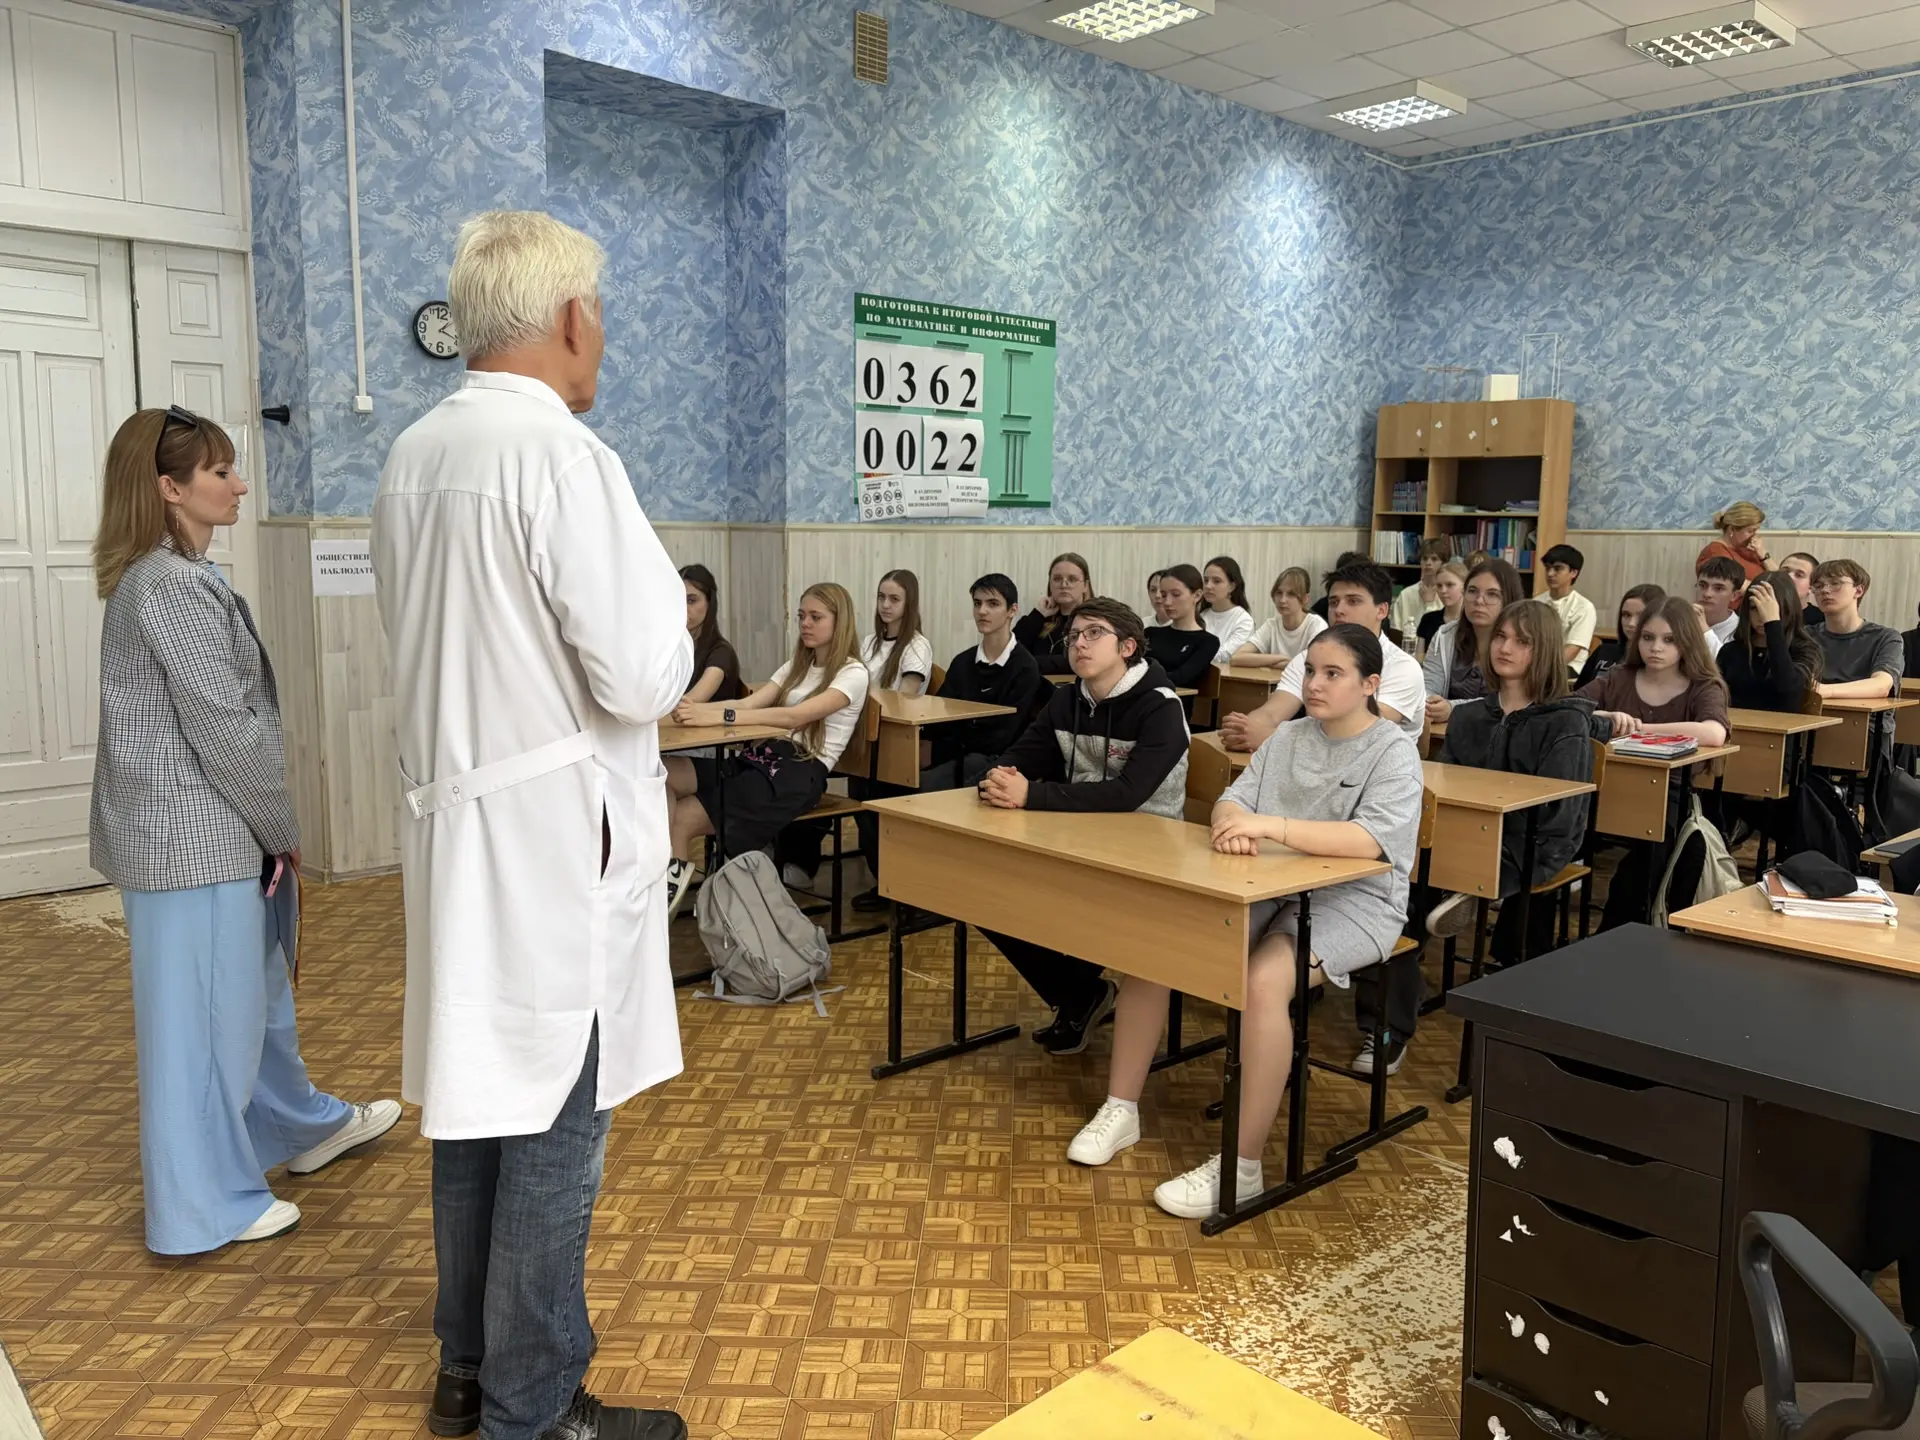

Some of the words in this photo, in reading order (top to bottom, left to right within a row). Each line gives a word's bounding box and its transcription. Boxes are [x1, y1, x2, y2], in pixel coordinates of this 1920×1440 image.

[435, 307, 448, 321] 12
[861, 297, 930, 314] ПОДГОТОВКА
[932, 306, 940, 316] К
[942, 308, 992, 322] ИТОГОВОЙ
[994, 315, 1050, 331] АТТЕСТАЦИИ
[419, 321, 427, 333] 9
[866, 313, 881, 322] ПО
[886, 316, 956, 332] МАТЕМАТИКЕ
[960, 325, 967, 334] И
[972, 327, 1041, 343] ИНФОРМАТИКЕ
[436, 341, 444, 353] 6
